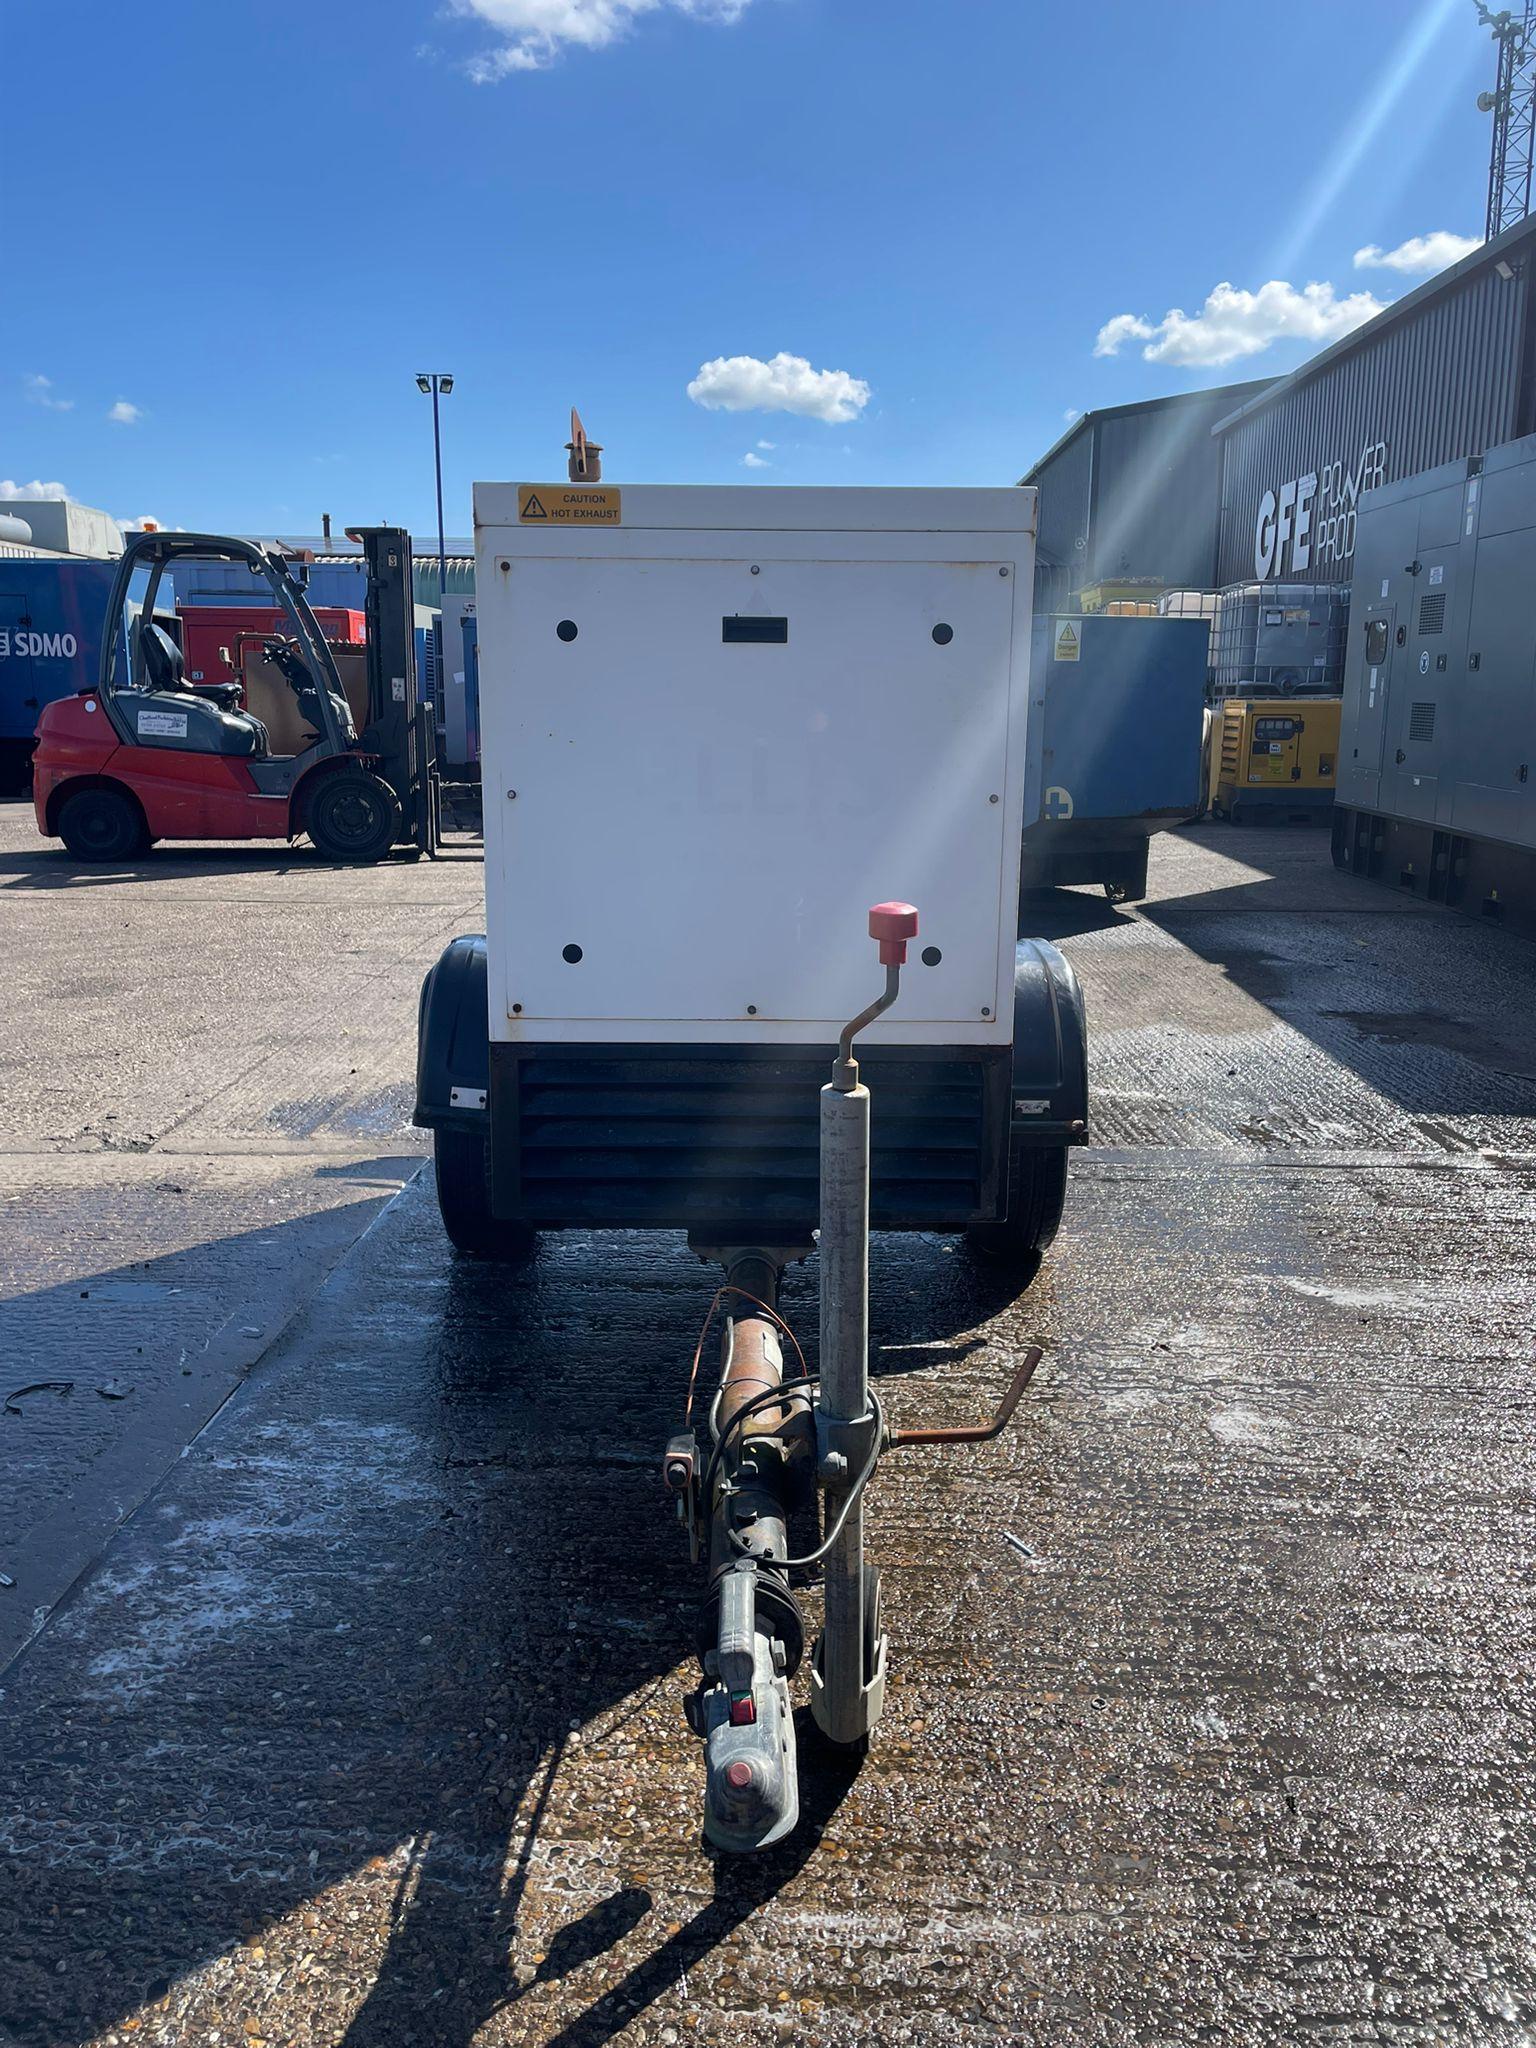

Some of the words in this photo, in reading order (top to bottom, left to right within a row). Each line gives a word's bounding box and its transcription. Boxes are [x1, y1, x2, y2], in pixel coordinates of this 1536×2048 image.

[1320, 432, 1387, 511] POWER
[563, 494, 606, 504] CAUTION
[551, 509, 571, 518] HOT
[573, 509, 619, 519] EXHAUST
[1255, 471, 1318, 580] GFE
[14, 632, 77, 658] SDMO
